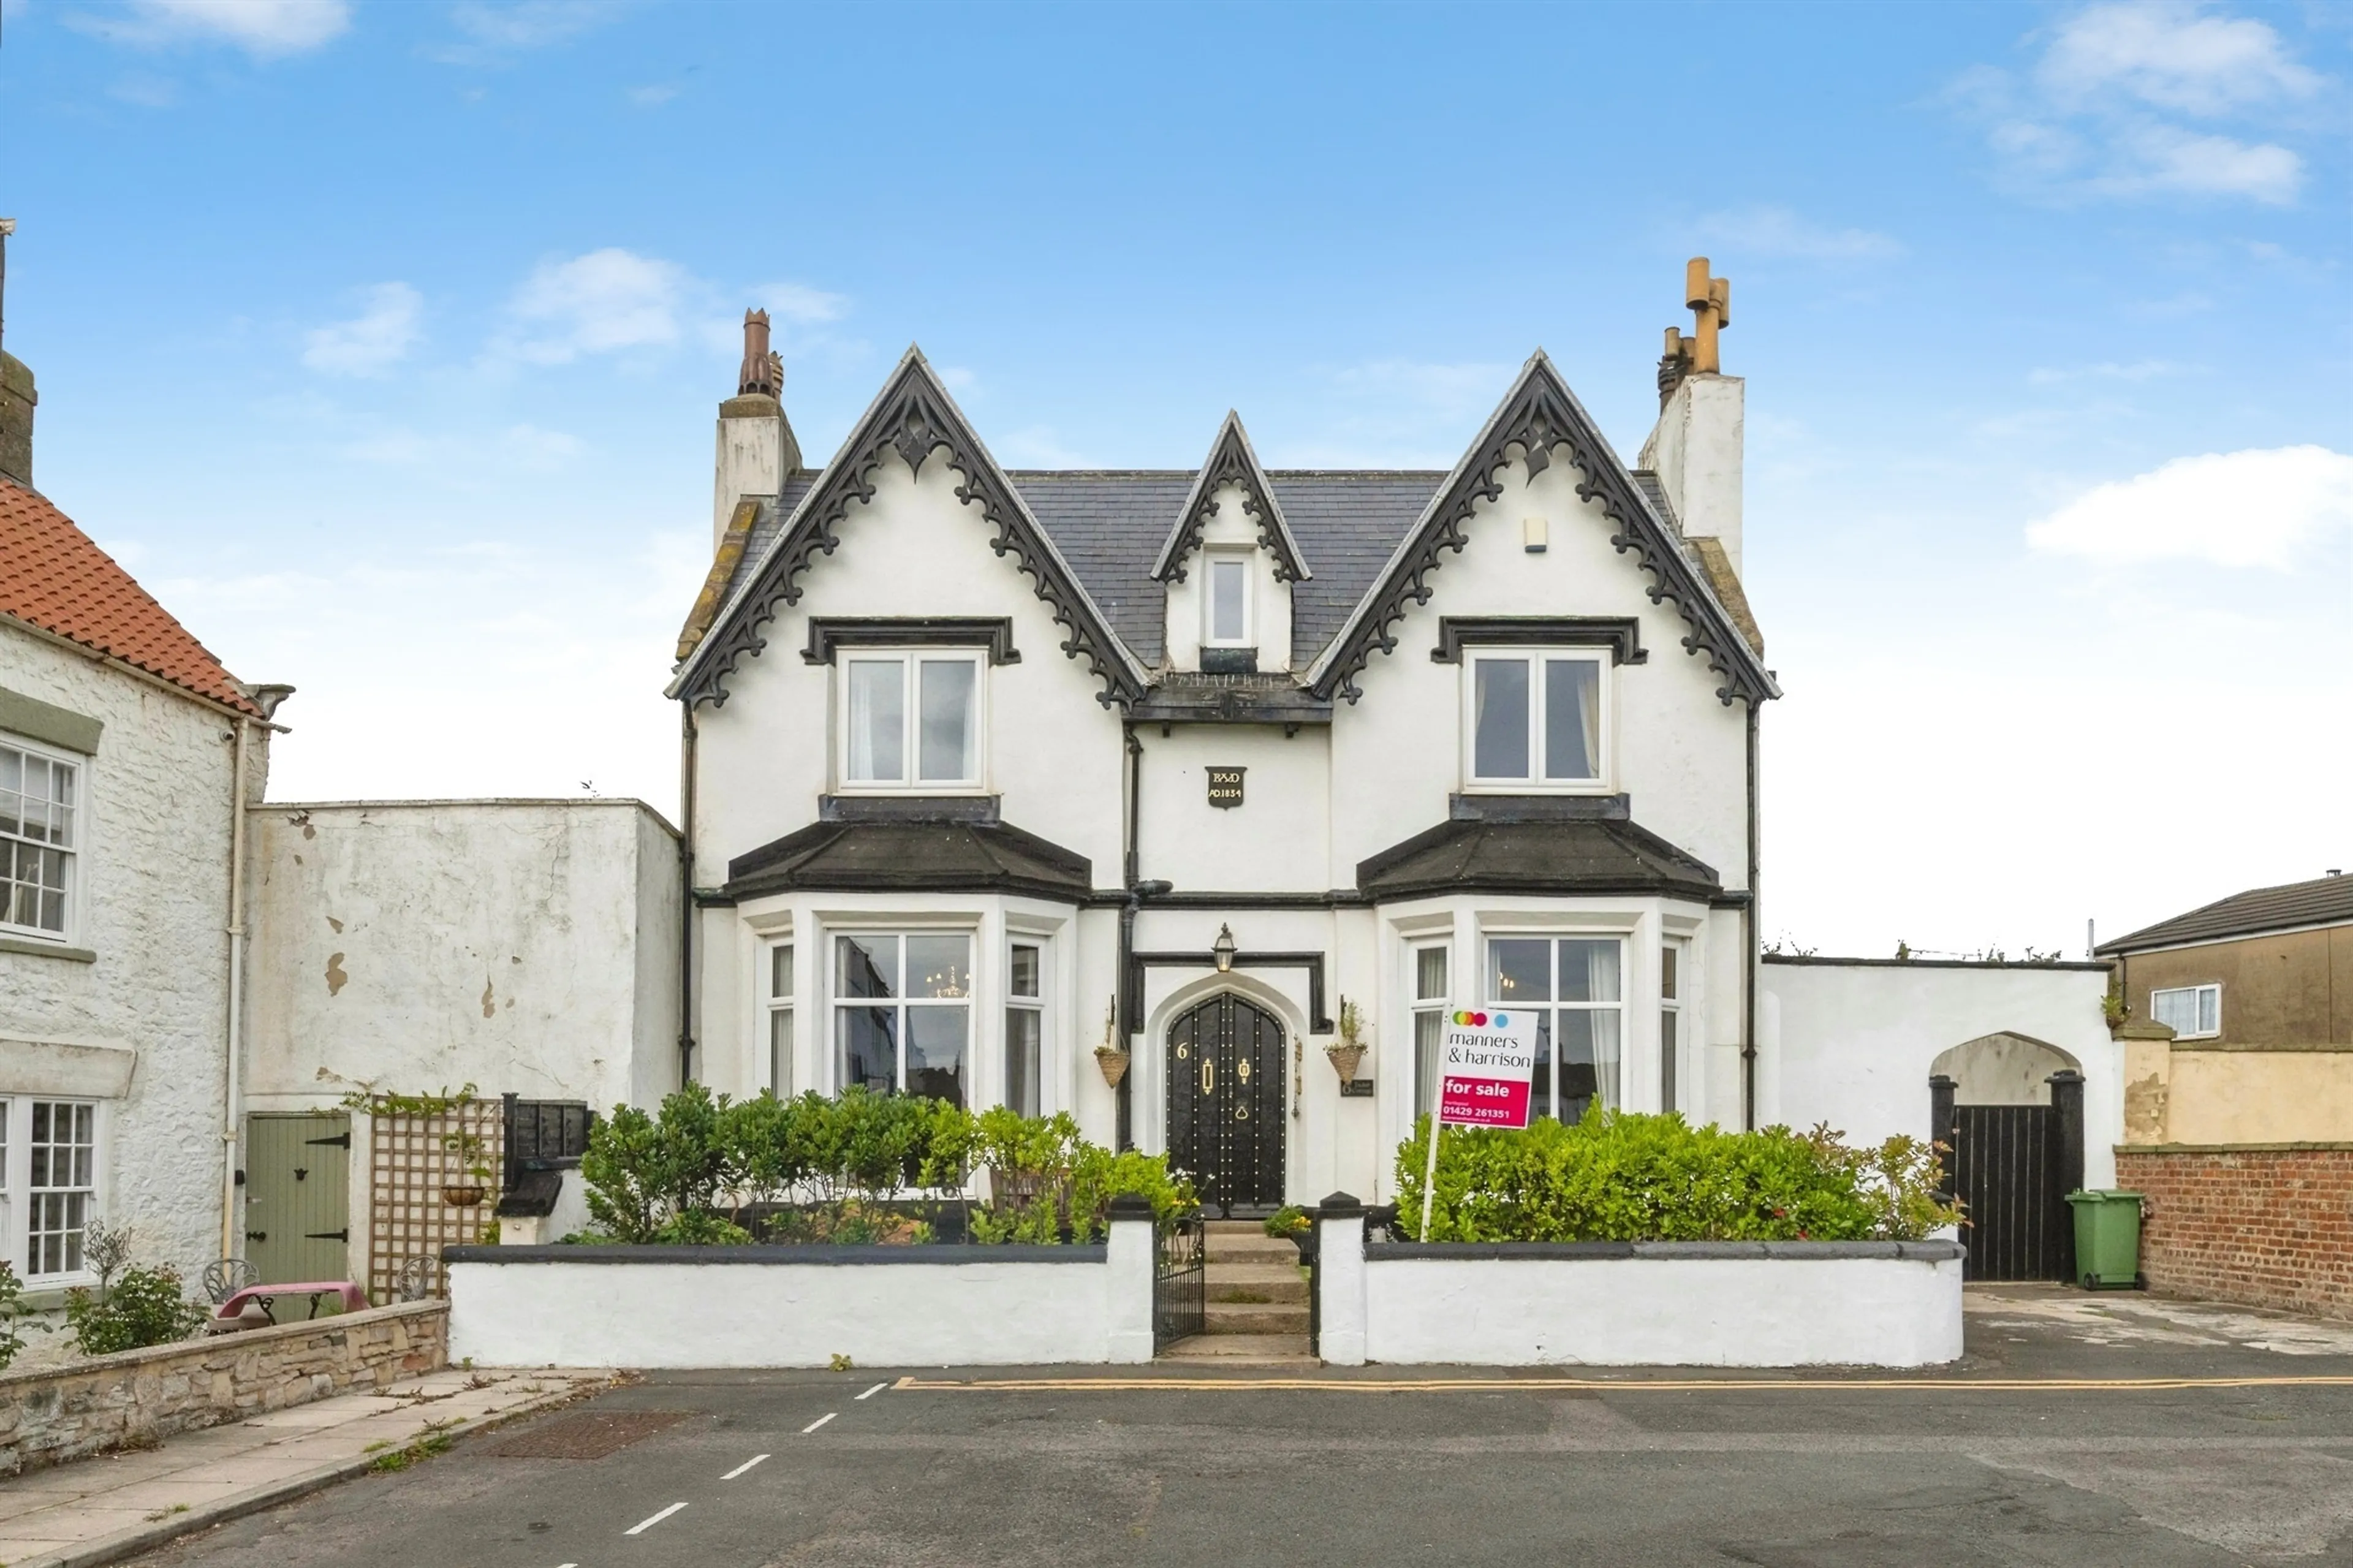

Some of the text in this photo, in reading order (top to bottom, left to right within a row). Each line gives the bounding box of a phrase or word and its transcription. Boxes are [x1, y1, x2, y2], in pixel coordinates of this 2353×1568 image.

[1449, 1033, 1518, 1048] manners
[1177, 1042, 1188, 1059] 6
[1449, 1047, 1530, 1067] & harrison
[1446, 1079, 1509, 1097] for sale
[1443, 1106, 1510, 1119] 01429 261351
